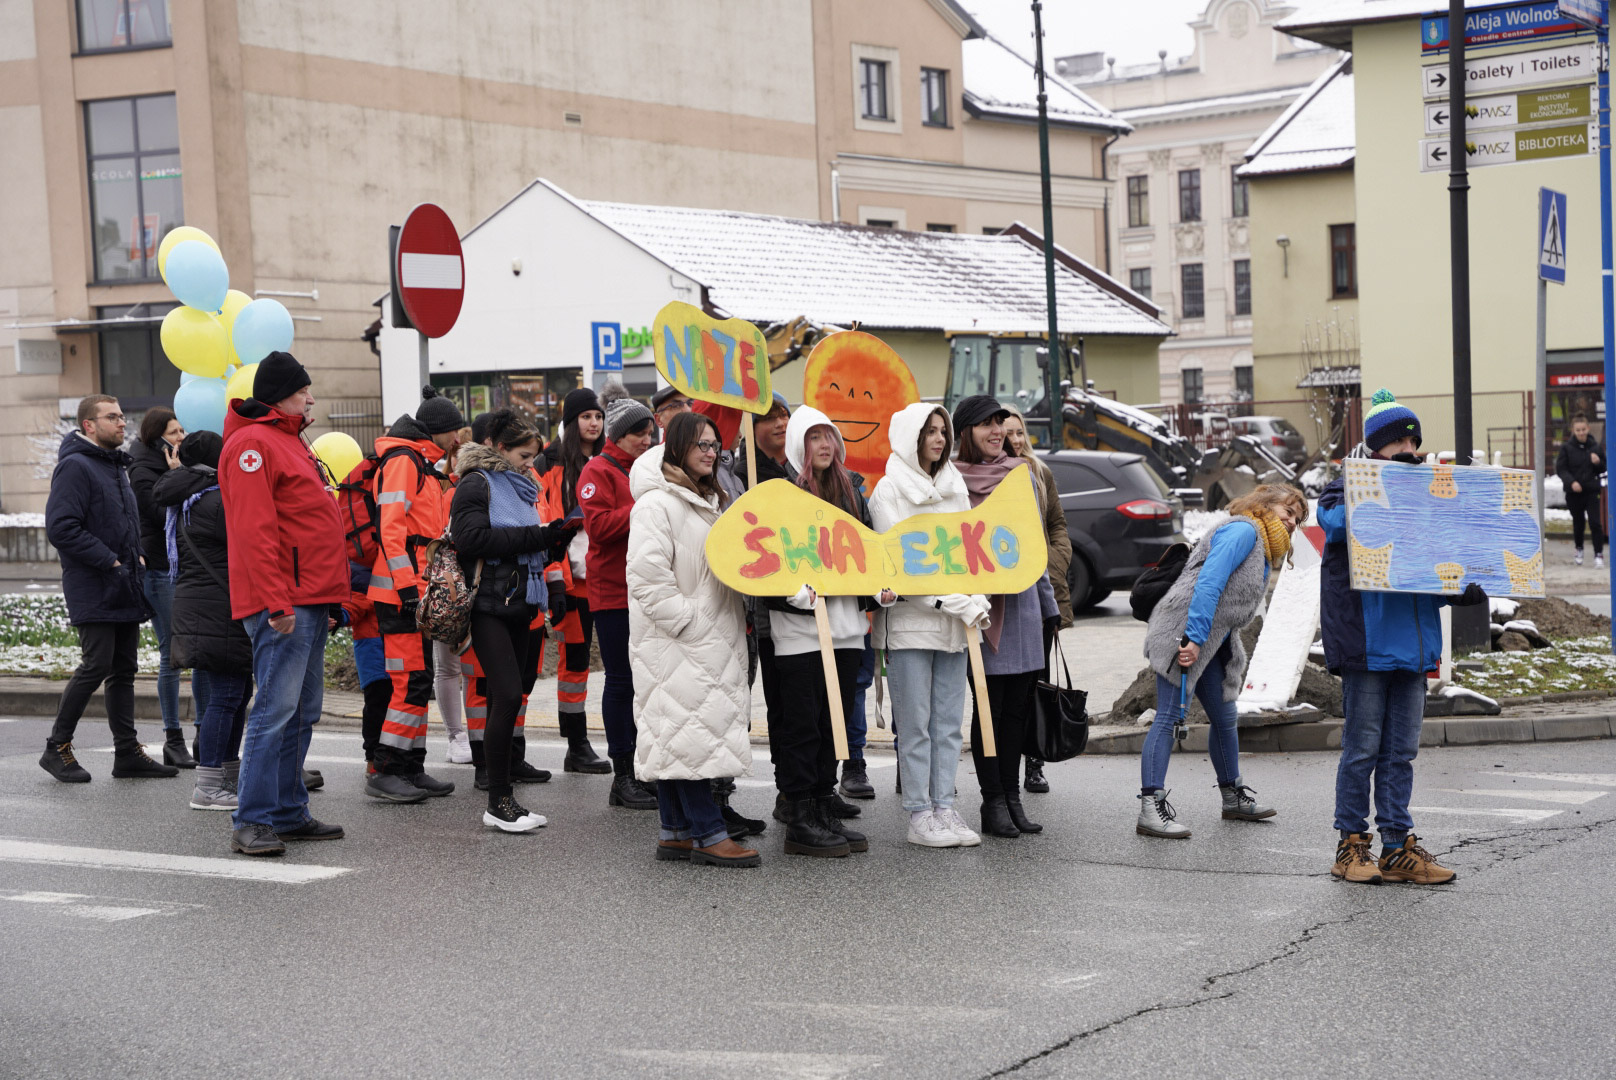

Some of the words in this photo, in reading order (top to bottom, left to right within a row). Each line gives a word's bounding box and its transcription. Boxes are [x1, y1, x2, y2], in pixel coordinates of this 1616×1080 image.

[1465, 13, 1501, 32] Aleja
[1506, 5, 1559, 26] Wolnoś
[1471, 33, 1499, 43] Osiedle
[1502, 29, 1535, 38] Centrum
[1531, 56, 1581, 72] Toilets
[1537, 92, 1570, 102] REKTORAT
[1480, 105, 1512, 119] PWSZ
[1530, 107, 1579, 119] EKONOMICZNY
[1538, 102, 1569, 112] INSTYTUT
[1478, 142, 1510, 156] PWSZ
[1518, 133, 1586, 151] BIBLIOTEKA
[92, 170, 133, 180] SCOLA
[70, 344, 77, 356] 6
[598, 326, 617, 366] P
[1557, 374, 1599, 385] WEJŚCIE
